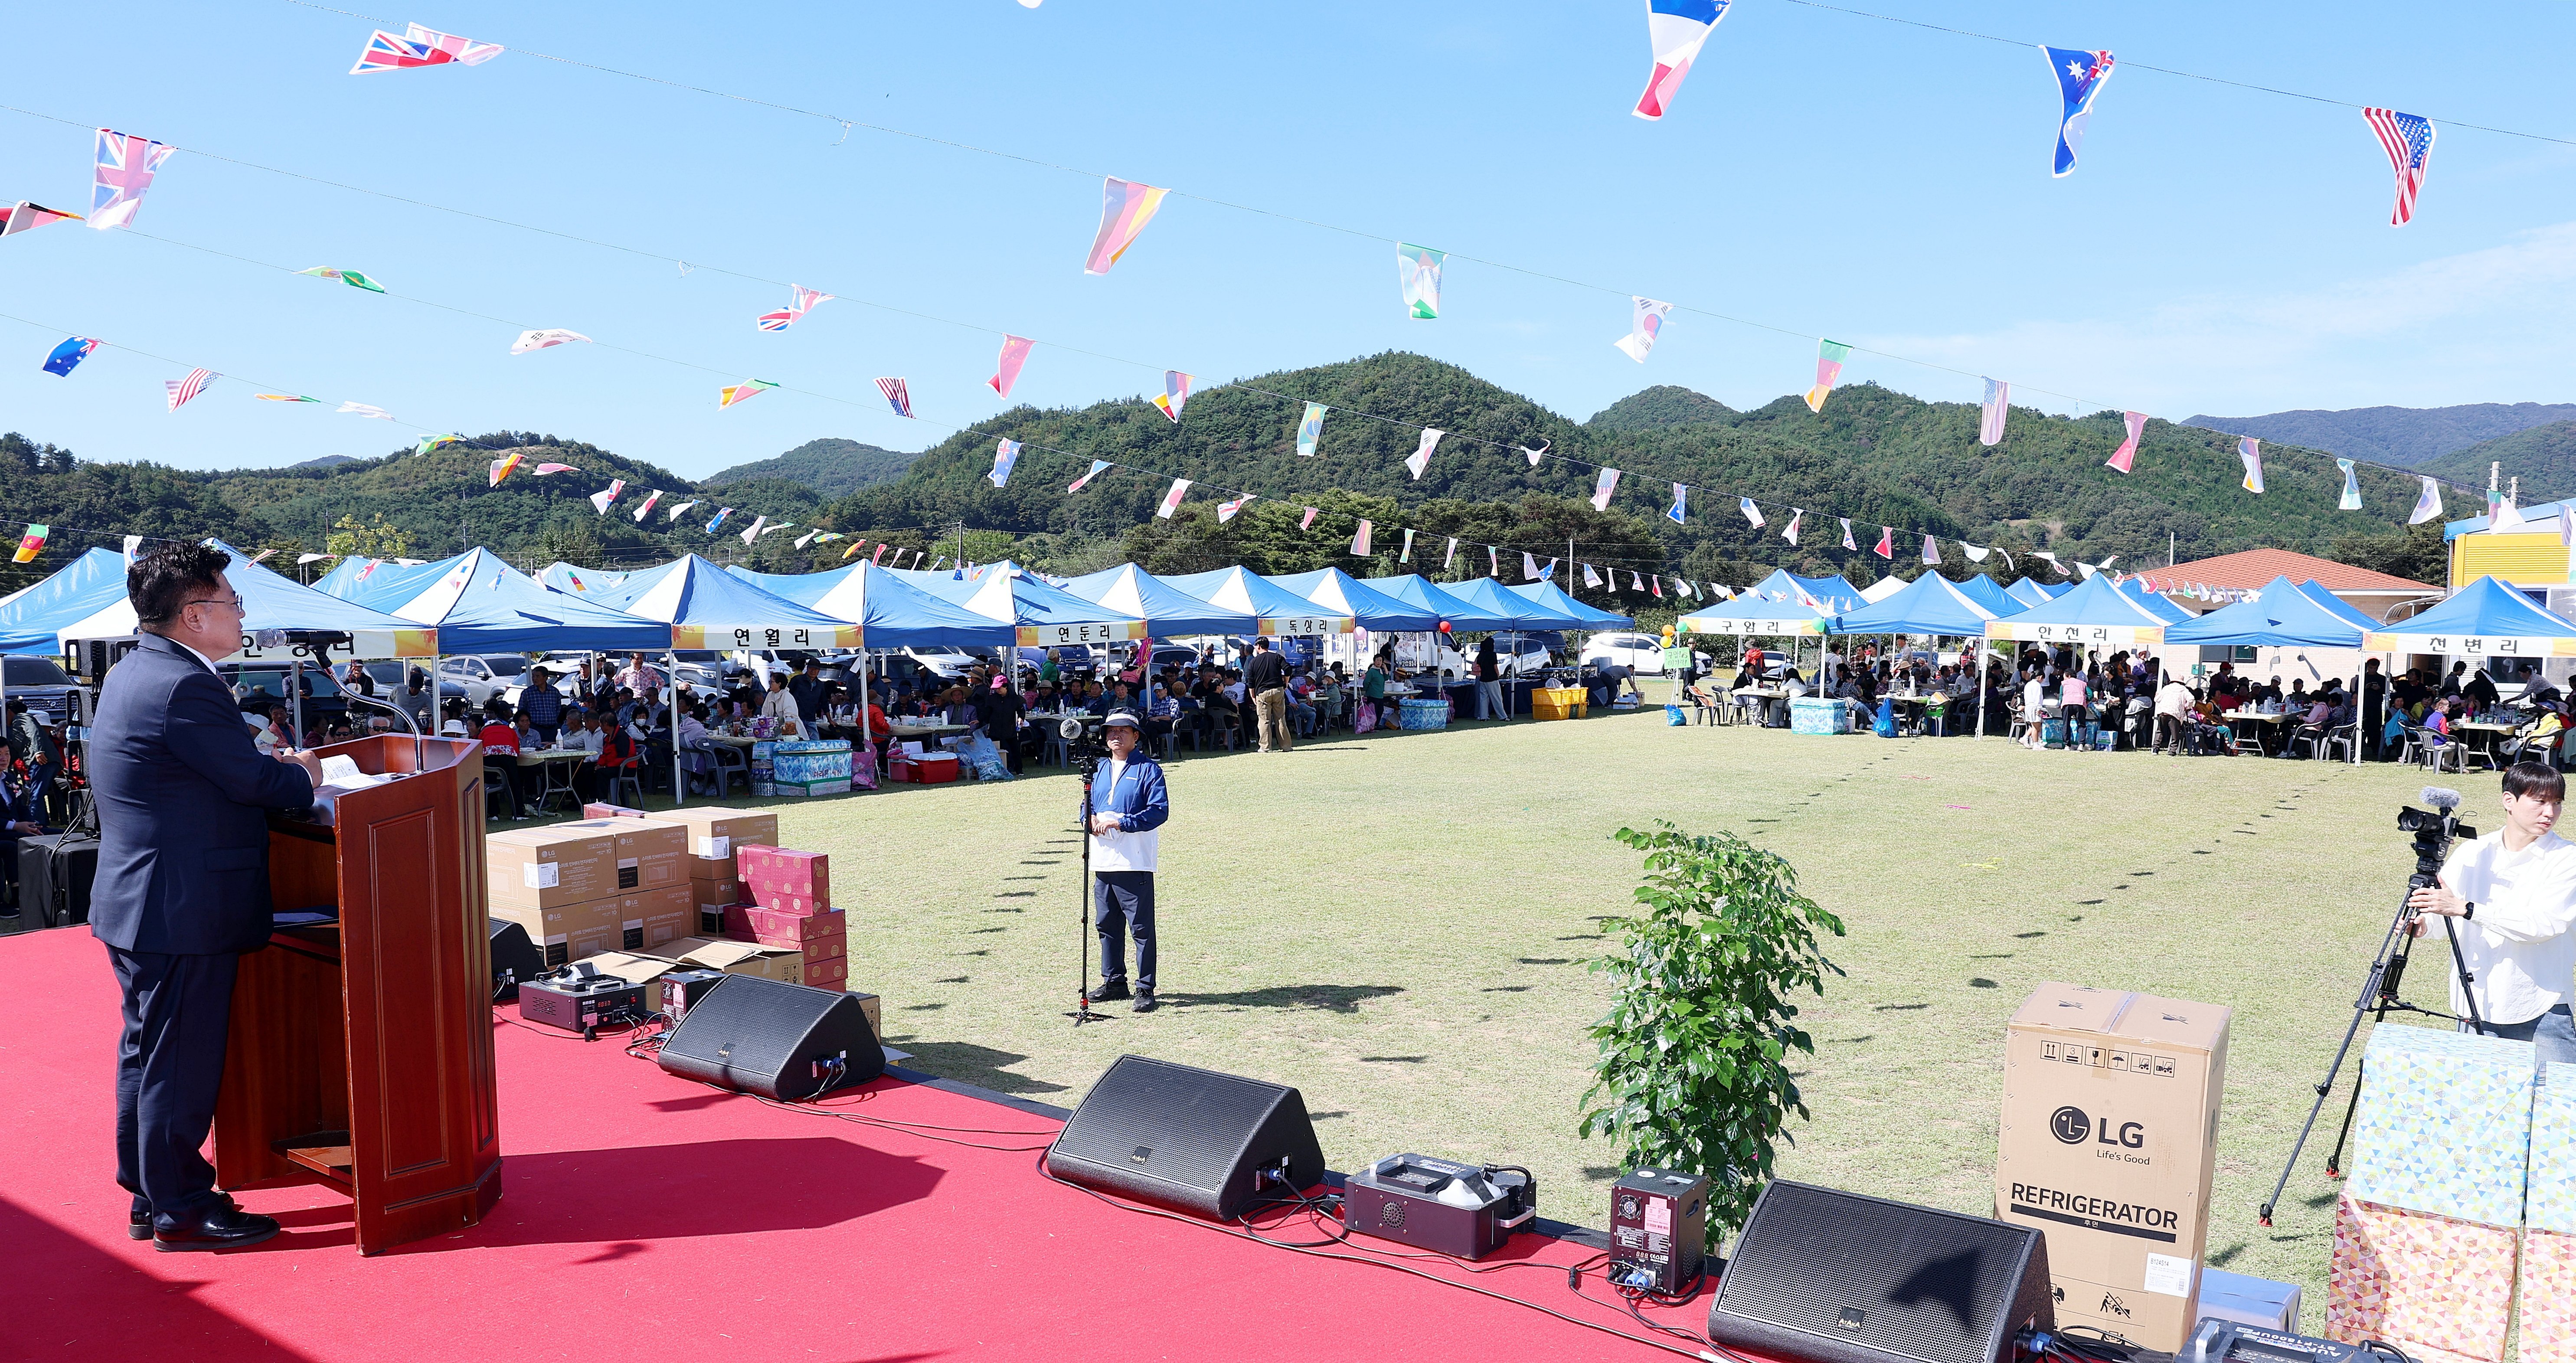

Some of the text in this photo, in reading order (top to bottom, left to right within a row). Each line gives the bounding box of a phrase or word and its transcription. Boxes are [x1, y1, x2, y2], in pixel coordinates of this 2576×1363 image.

[1058, 624, 1110, 642] 연둔리
[1289, 620, 1327, 634] 독상리
[1722, 621, 1778, 633] 구암리
[2038, 626, 2108, 641] 한천리
[734, 628, 809, 647] 연월리
[2429, 637, 2517, 654] 천변리
[2098, 1118, 2144, 1148] LG
[2097, 1149, 2151, 1165] Life's Good
[2011, 1182, 2178, 1230] REFRIGERATOR
[2151, 1258, 2169, 1266] B124S14
